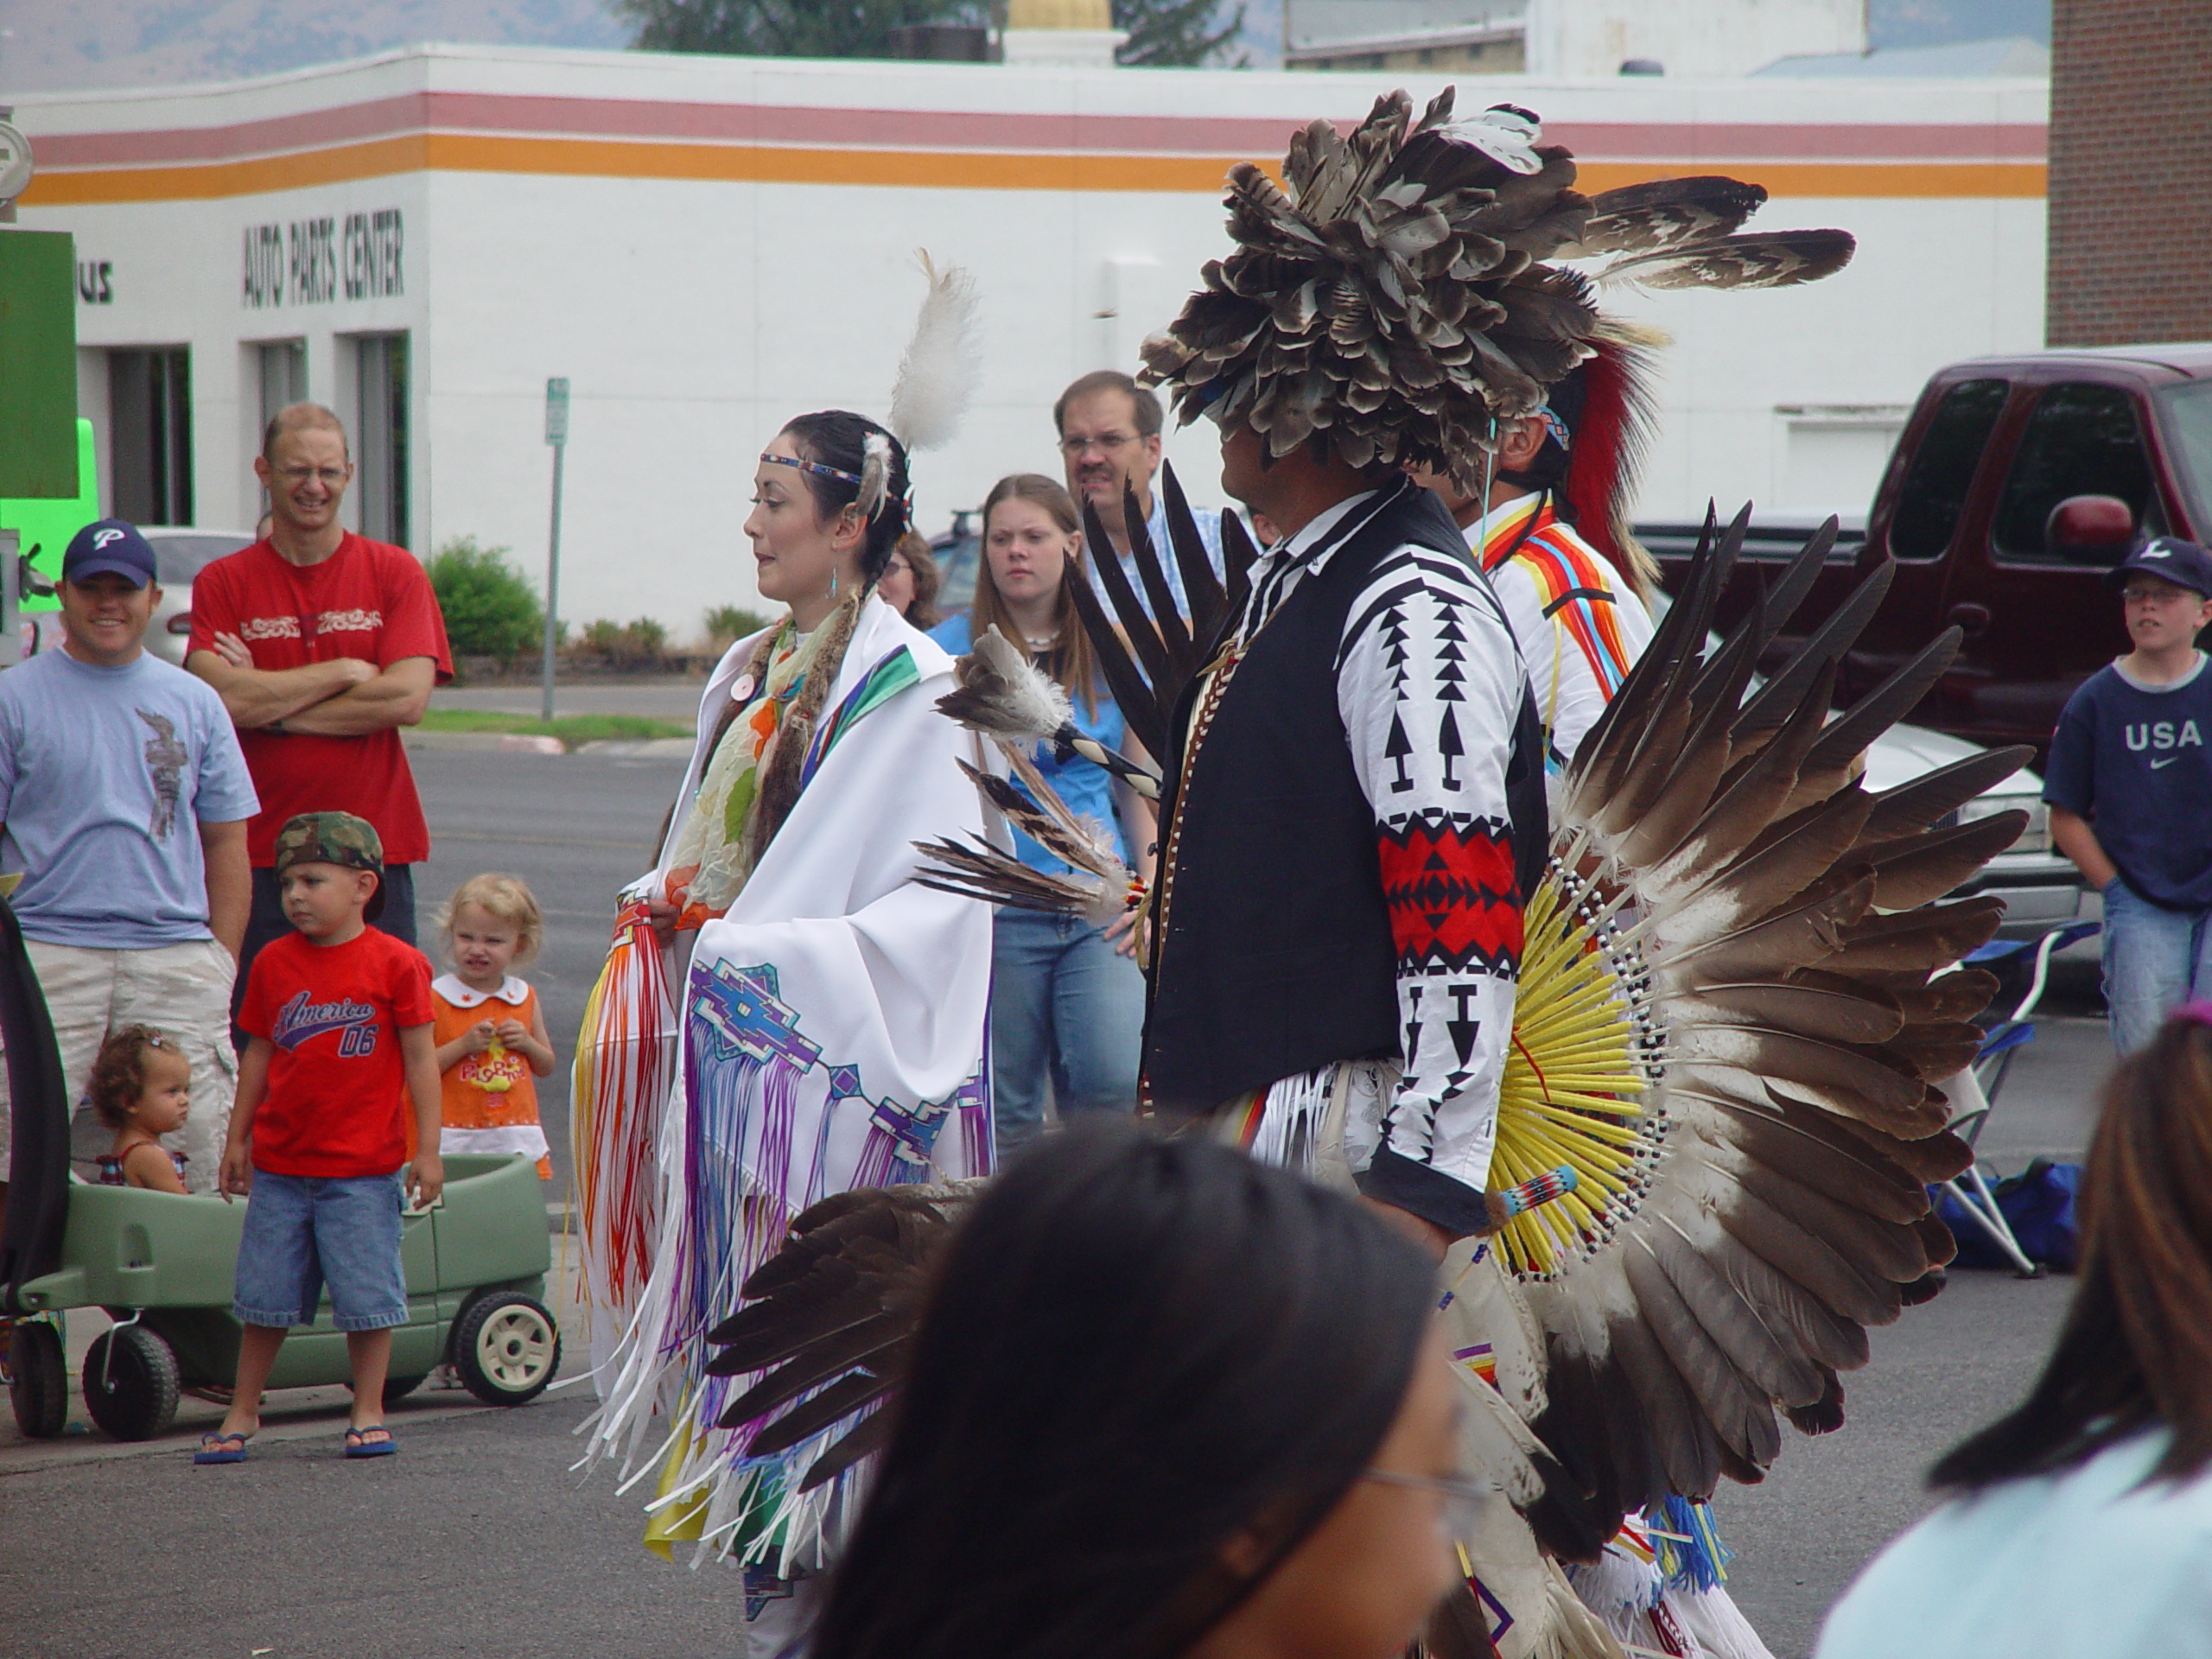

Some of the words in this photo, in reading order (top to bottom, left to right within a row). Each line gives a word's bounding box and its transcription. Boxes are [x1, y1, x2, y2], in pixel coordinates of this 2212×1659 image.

[243, 224, 284, 309] AUTO
[290, 217, 337, 307] PARTS
[344, 208, 404, 301] CENTER
[93, 529, 125, 550] P
[2126, 720, 2202, 751] USA
[273, 990, 375, 1041] America
[338, 1024, 379, 1058] 06
